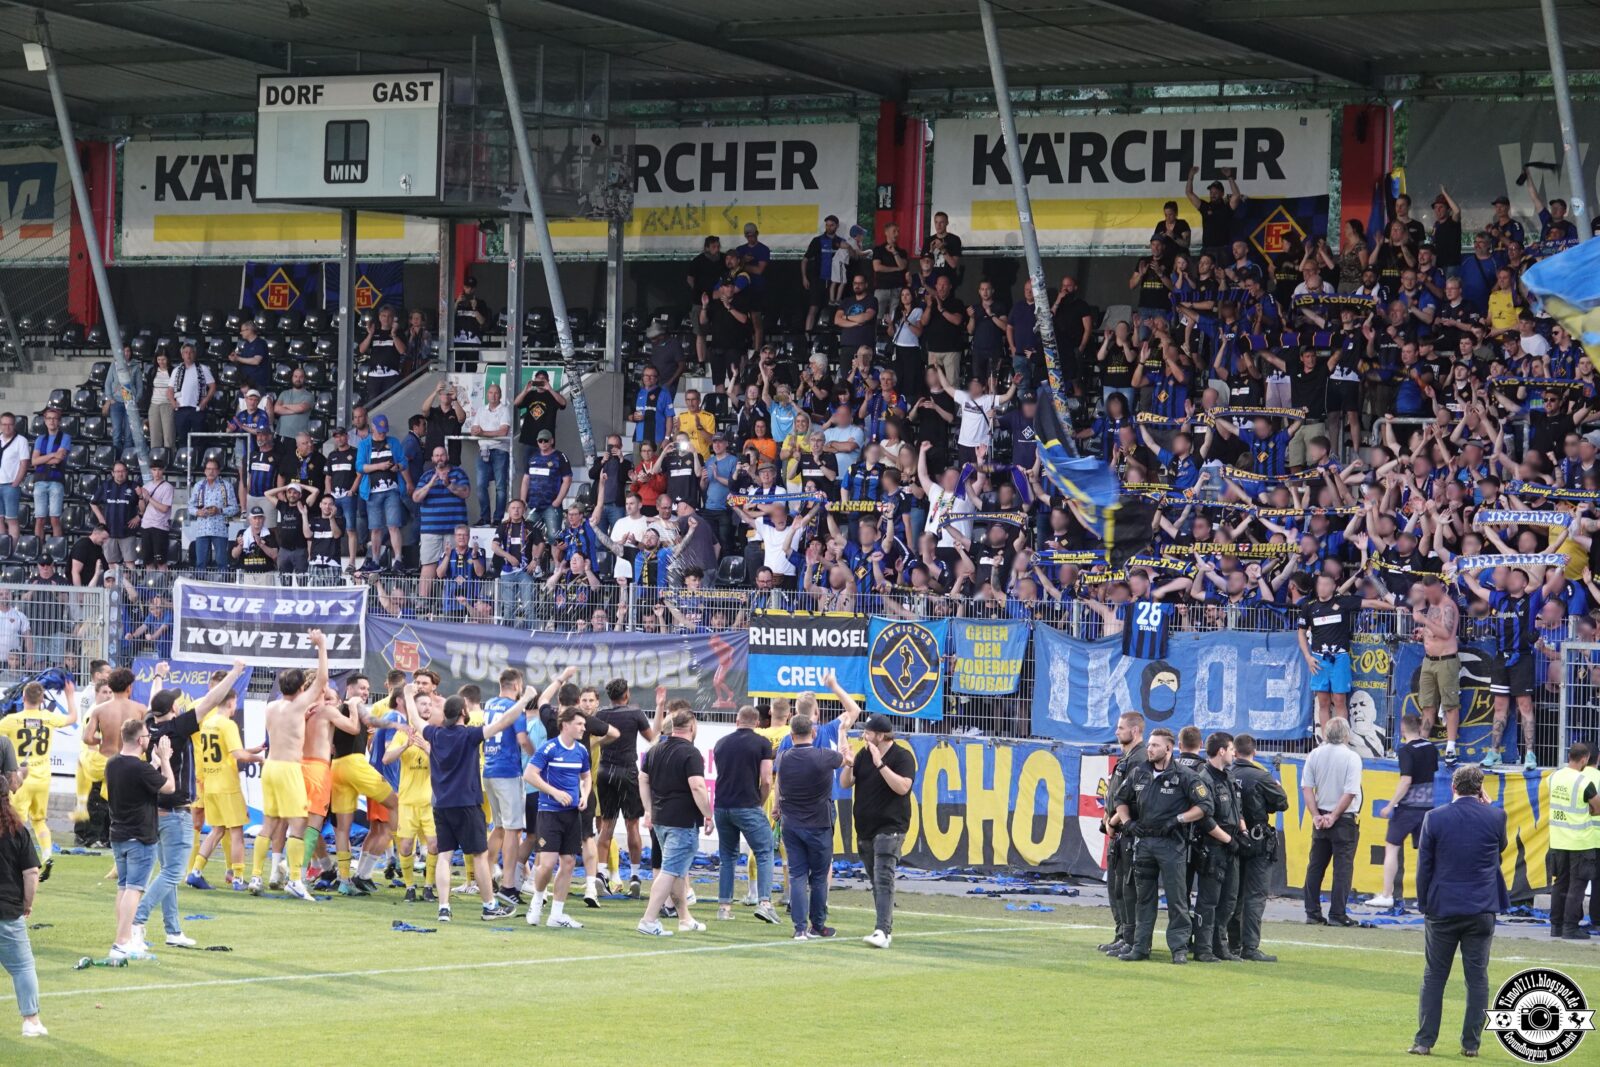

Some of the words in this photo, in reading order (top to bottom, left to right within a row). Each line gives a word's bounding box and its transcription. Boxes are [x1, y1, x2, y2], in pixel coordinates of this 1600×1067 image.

[265, 84, 325, 105] DORF
[372, 81, 434, 103] GAST
[972, 126, 1286, 186] KÄRCHER
[154, 154, 253, 201] KÄR
[330, 164, 362, 181] MIN
[187, 593, 266, 614] BLUE
[274, 598, 356, 617] BOYS
[749, 626, 807, 648] RHEIN
[812, 628, 869, 649] MOSEL
[965, 625, 1008, 642] GEGEN
[973, 642, 1001, 658] DEN
[200, 733, 222, 763] 25
